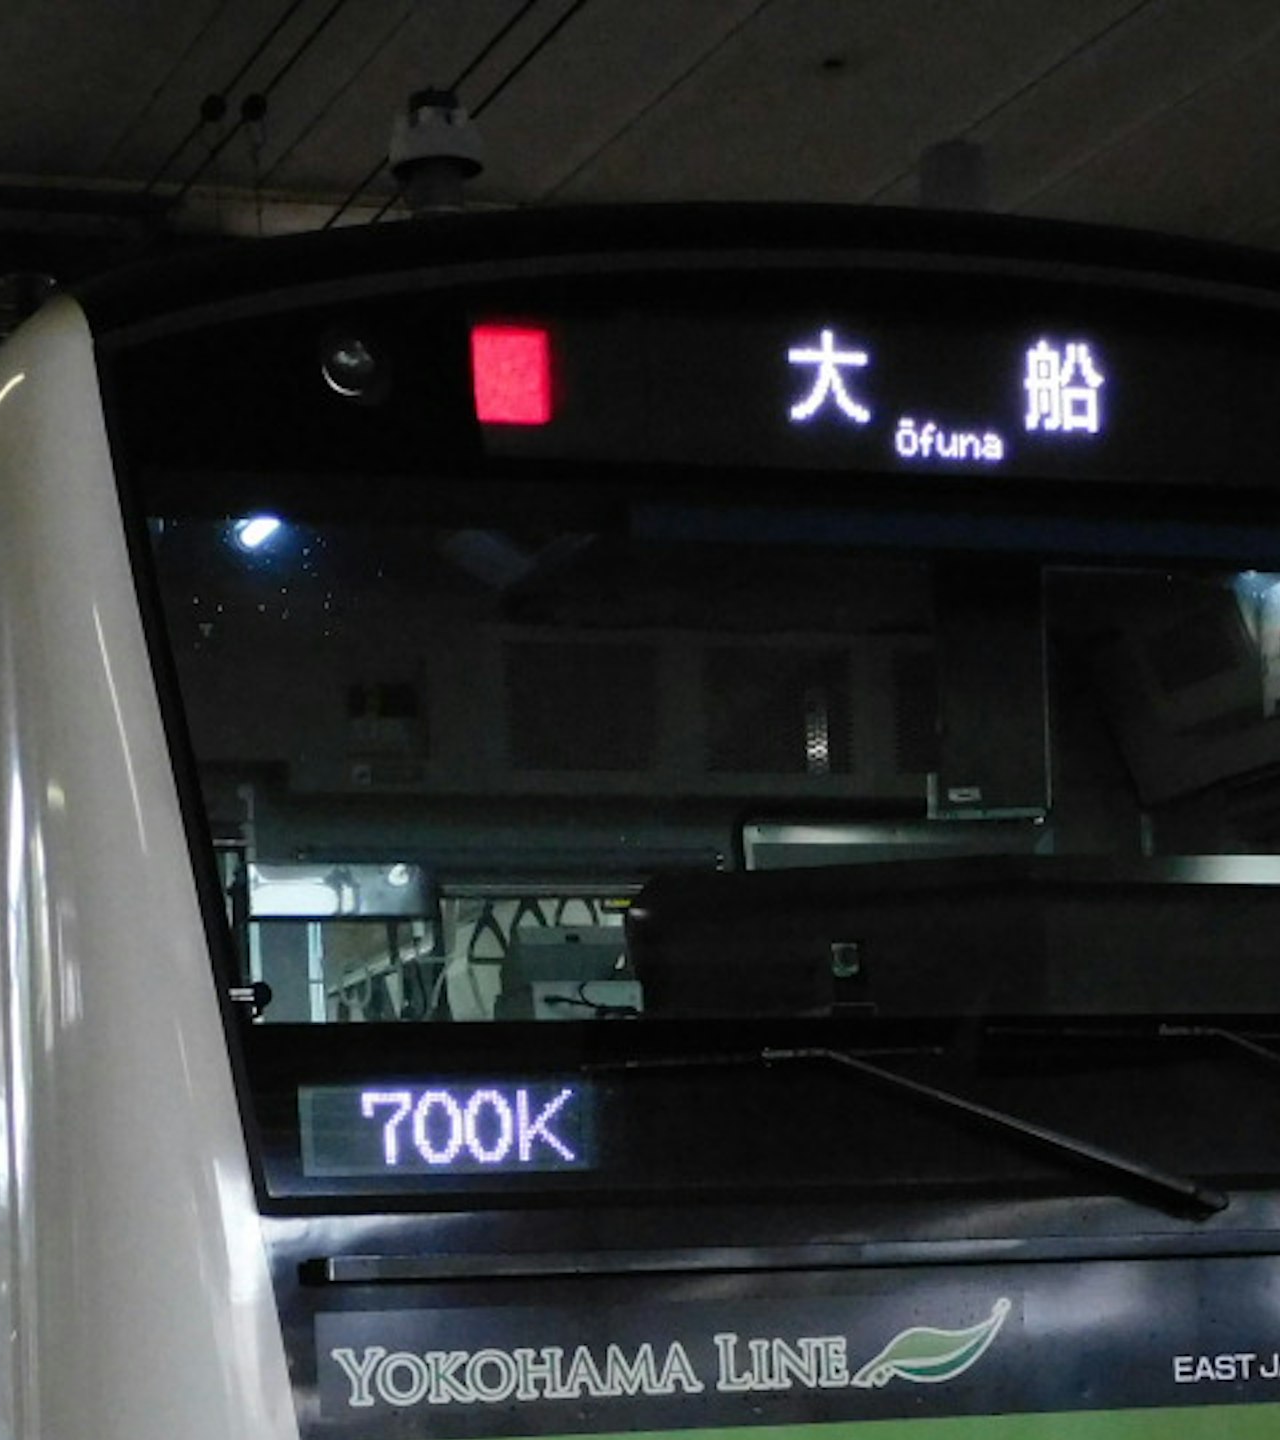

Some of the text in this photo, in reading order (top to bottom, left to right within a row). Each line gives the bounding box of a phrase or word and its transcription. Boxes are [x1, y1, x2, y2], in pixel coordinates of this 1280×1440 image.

[360, 1088, 576, 1166] 700K
[332, 1333, 850, 1406] YOKOHAMA LINE
[1173, 1353, 1256, 1383] EAST
